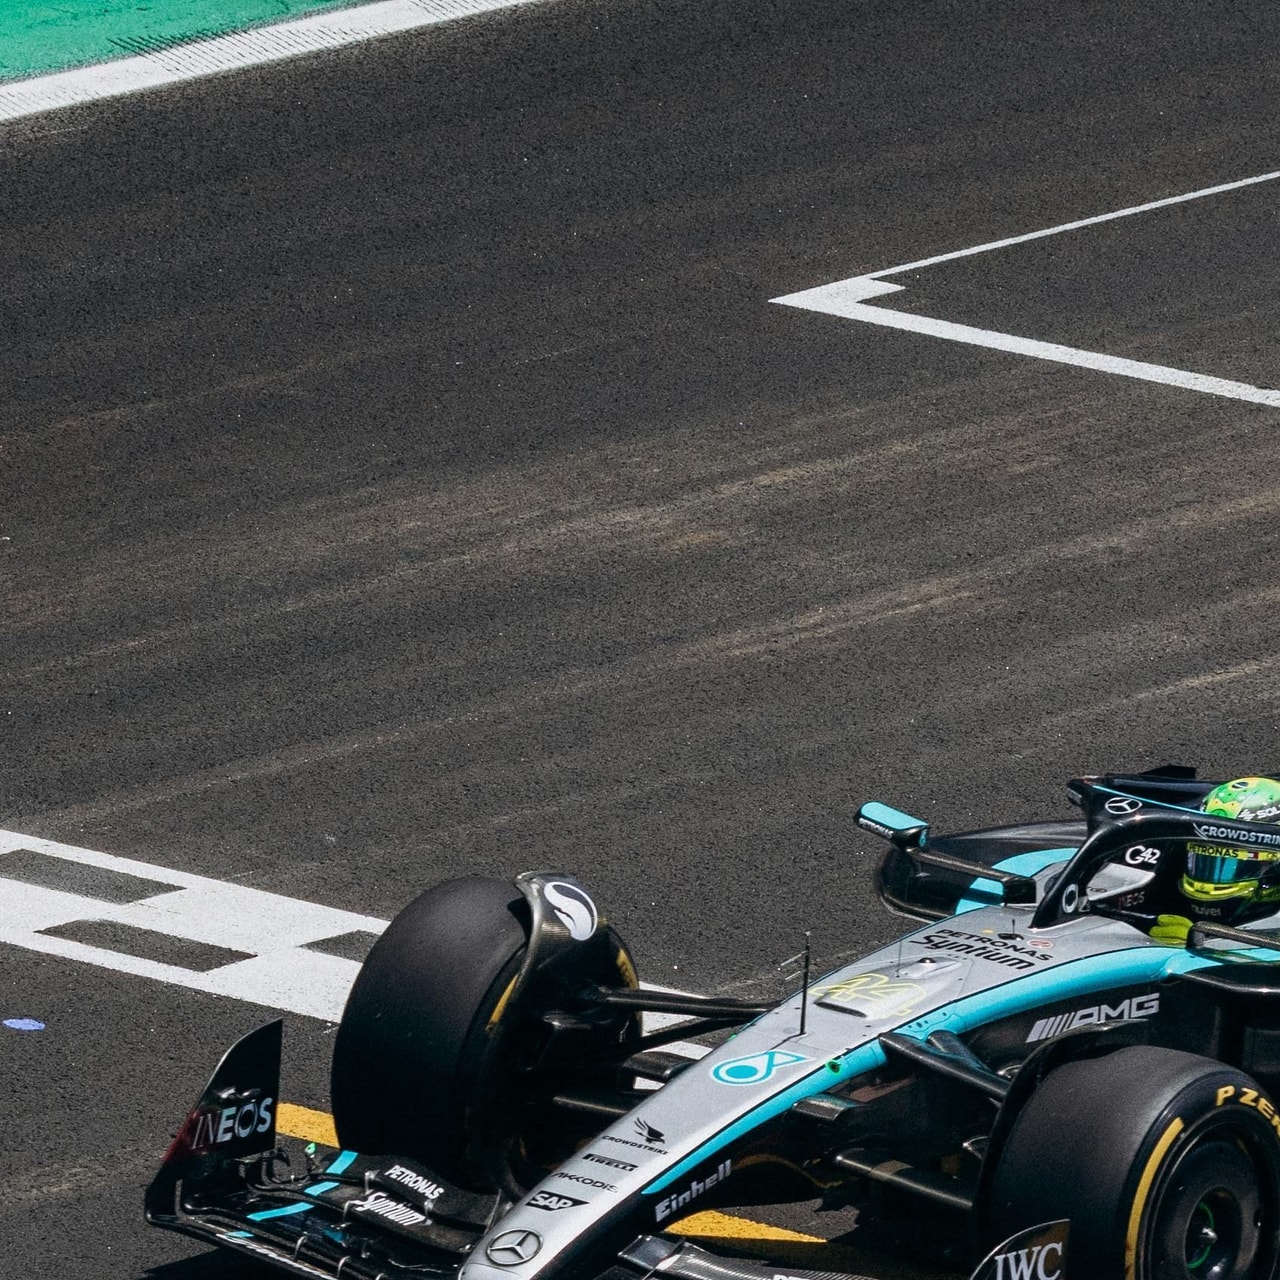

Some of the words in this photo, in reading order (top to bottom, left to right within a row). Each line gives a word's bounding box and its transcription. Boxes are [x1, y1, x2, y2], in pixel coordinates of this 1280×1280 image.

[1125, 845, 1160, 864] G42
[910, 934, 1035, 970] Syntium
[935, 928, 1054, 961] PETRONAS
[1216, 1085, 1235, 1107] P
[191, 1097, 274, 1150] INEOS
[384, 1165, 446, 1200] PETRONAS
[654, 1158, 733, 1223] Einhell
[355, 1190, 426, 1227] Syntium
[531, 1193, 577, 1210] SAP
